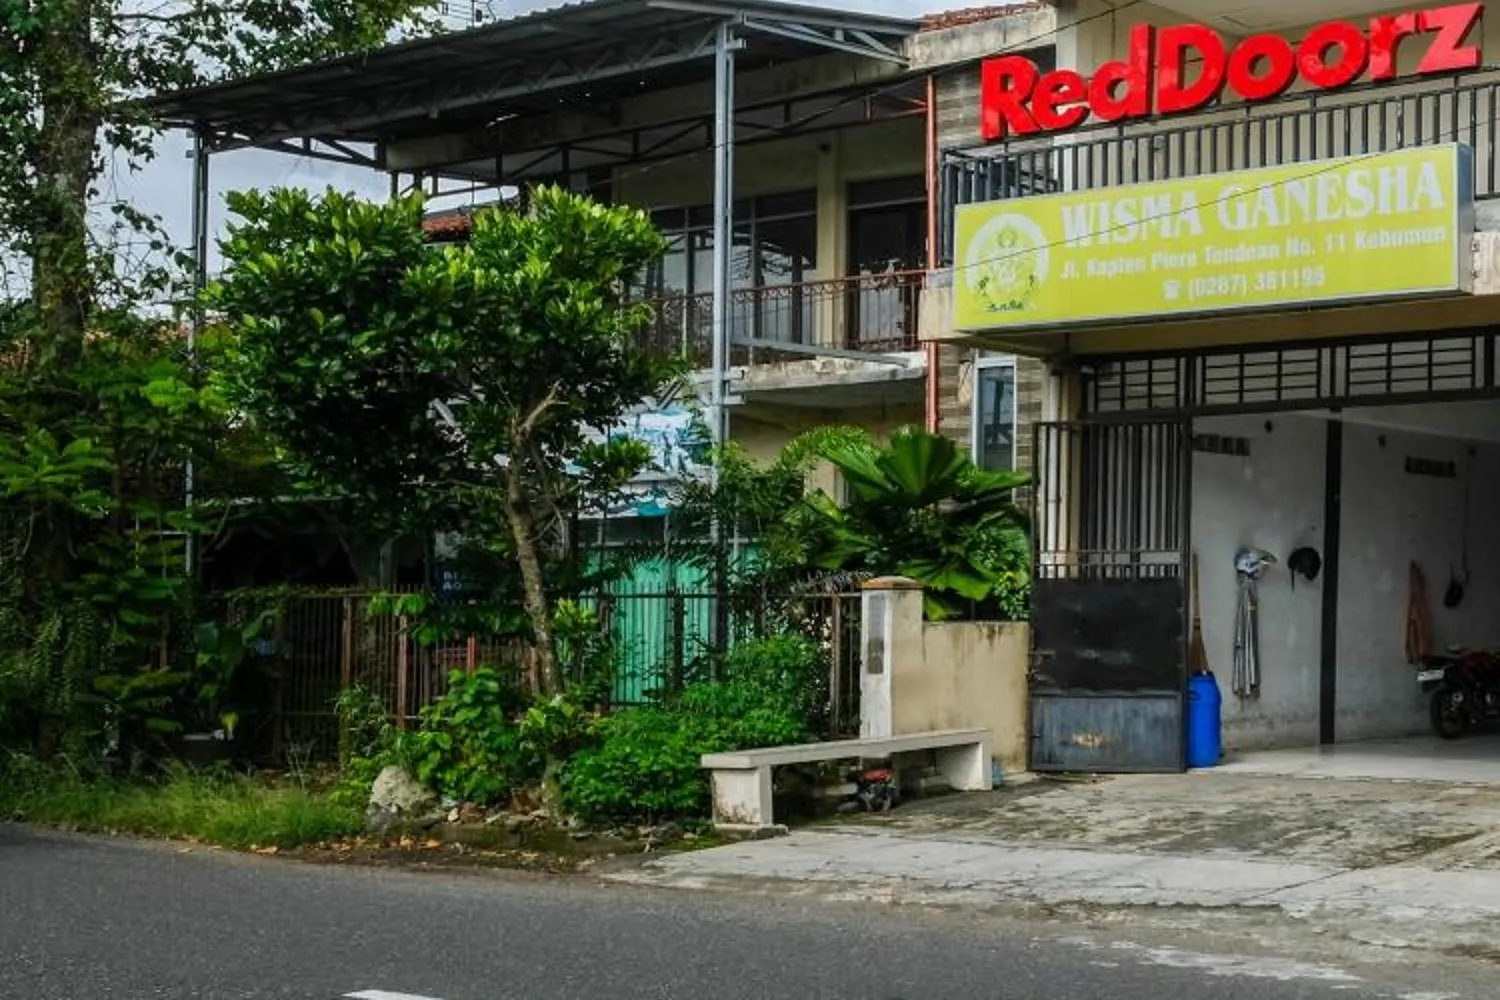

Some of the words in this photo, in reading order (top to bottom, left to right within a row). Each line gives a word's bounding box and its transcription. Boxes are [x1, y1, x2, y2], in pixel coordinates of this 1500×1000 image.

[980, 2, 1484, 142] RedDoorz
[1061, 190, 1203, 249] WISMA
[1217, 161, 1445, 231] GANESHA
